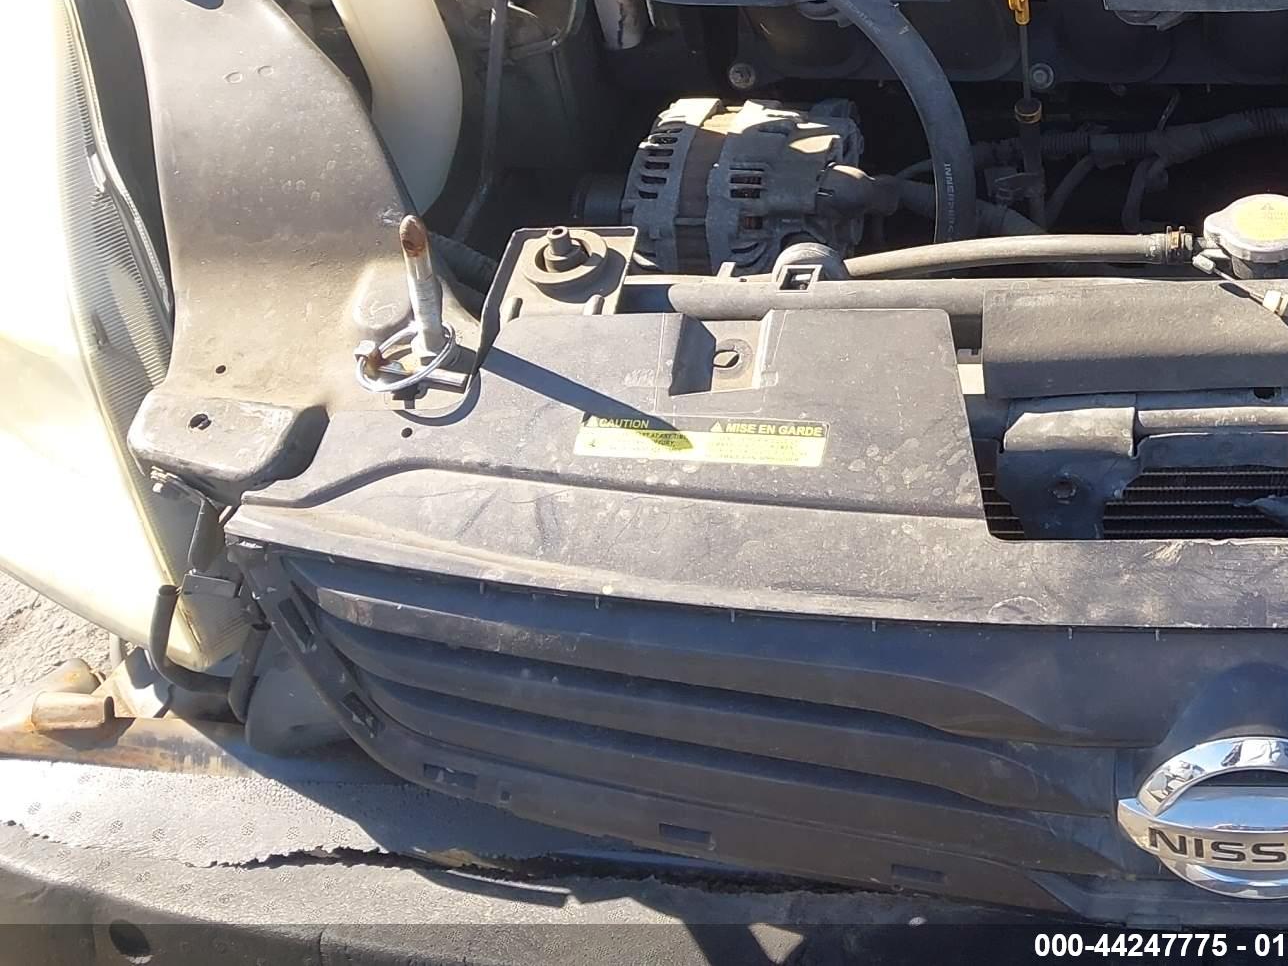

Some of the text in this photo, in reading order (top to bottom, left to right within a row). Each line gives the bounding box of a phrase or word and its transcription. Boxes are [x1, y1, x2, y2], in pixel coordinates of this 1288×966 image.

[600, 418, 649, 430] CAUTION
[725, 423, 823, 437] MISE EN GARDE
